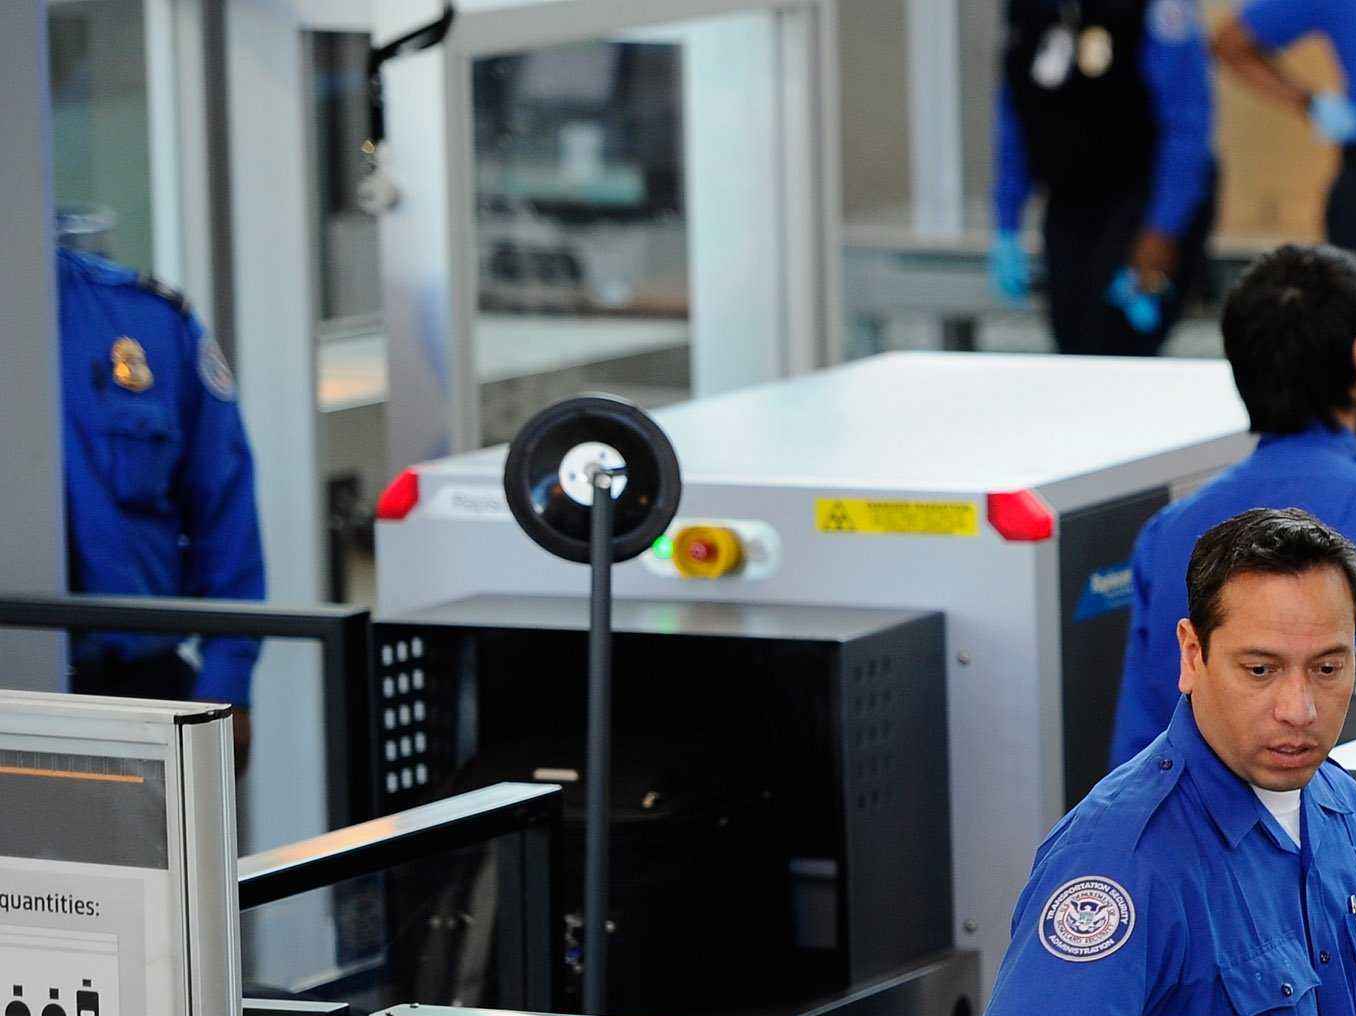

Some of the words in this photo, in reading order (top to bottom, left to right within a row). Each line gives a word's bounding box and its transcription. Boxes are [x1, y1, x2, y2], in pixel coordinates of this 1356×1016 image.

[0, 893, 100, 917] quantities:
[1046, 882, 1110, 920] TRANSPORTATION
[1048, 934, 1116, 955] ADMINISTRATION
